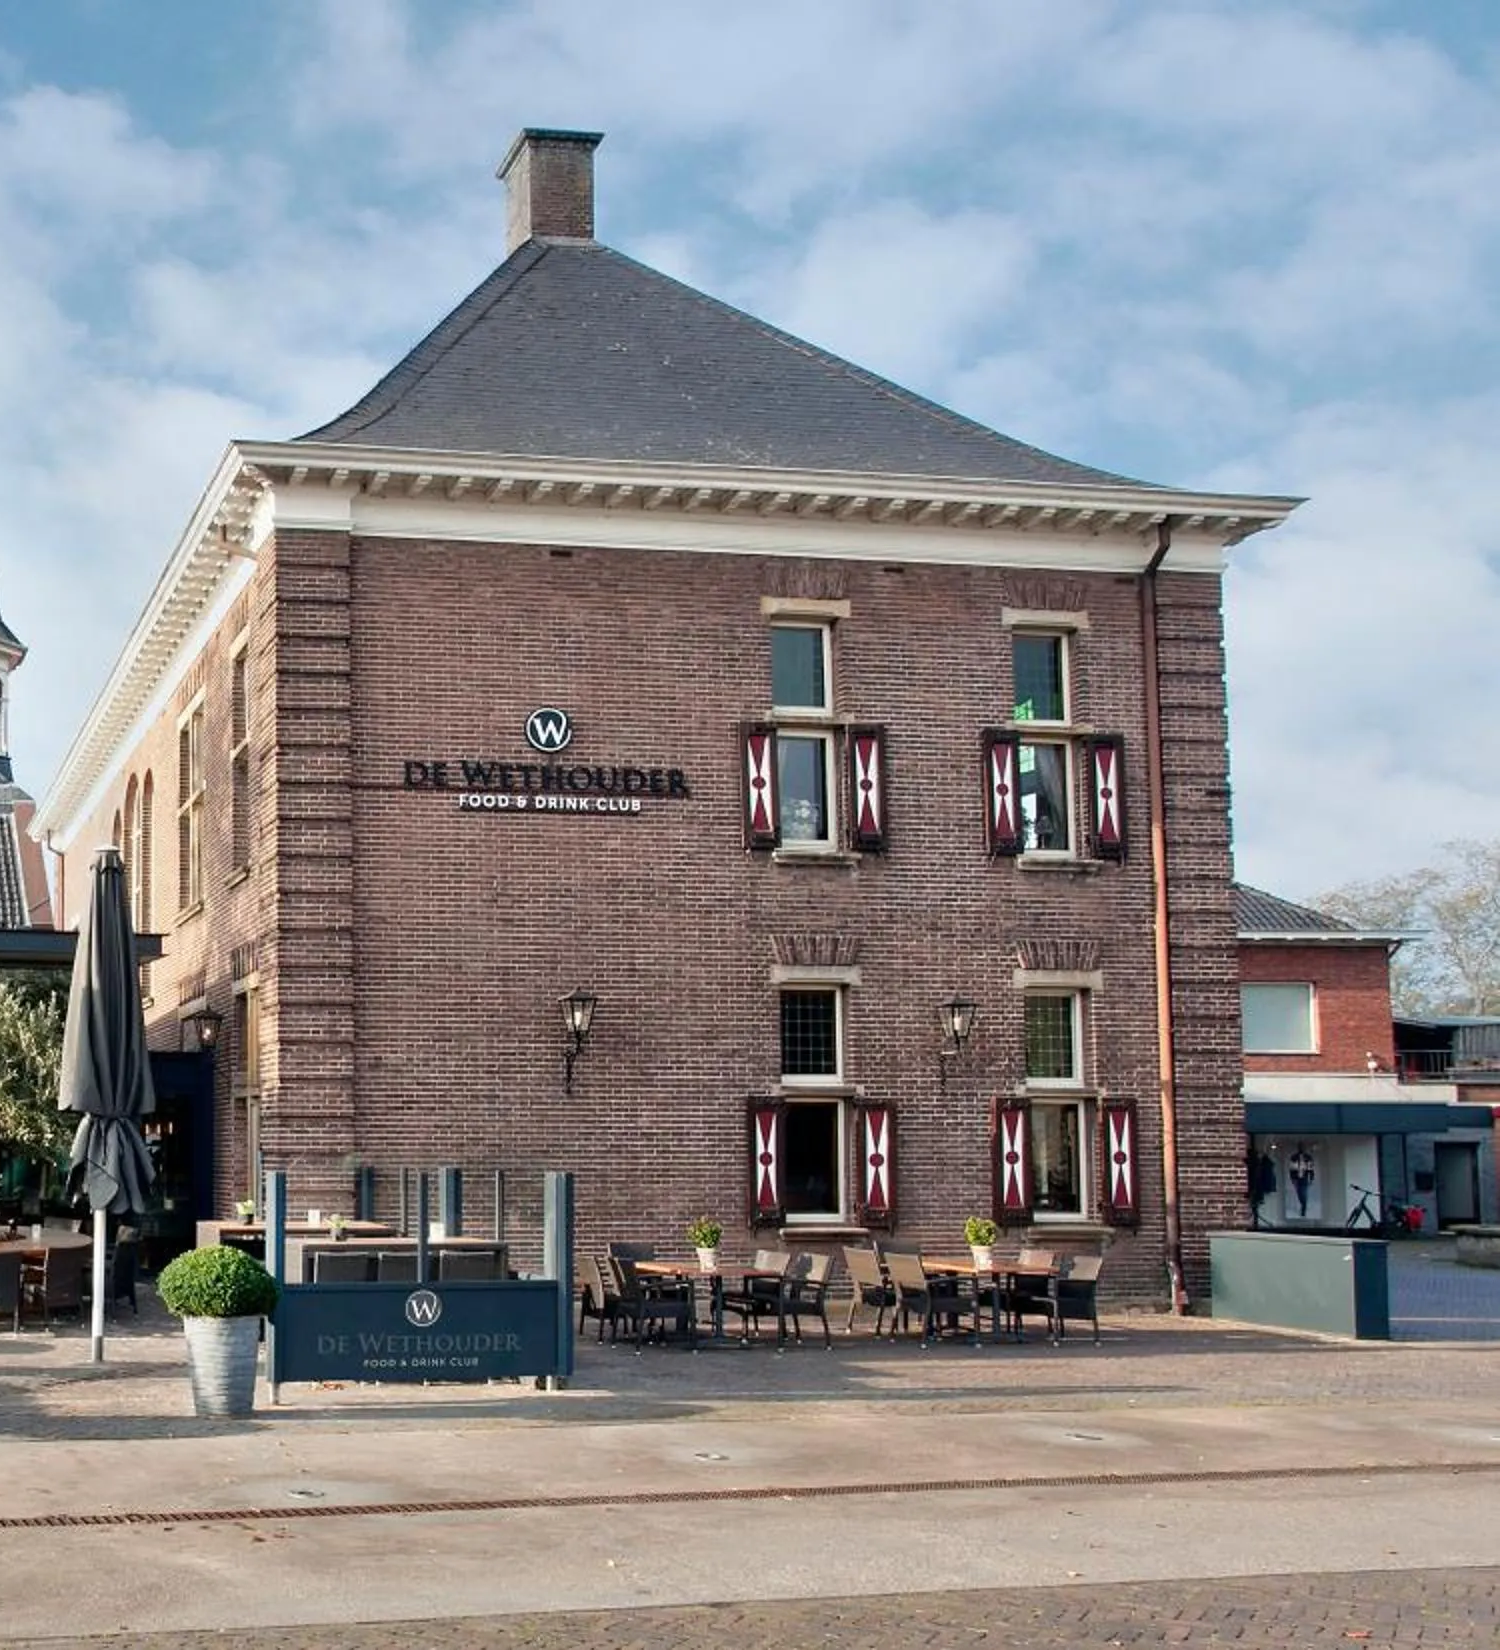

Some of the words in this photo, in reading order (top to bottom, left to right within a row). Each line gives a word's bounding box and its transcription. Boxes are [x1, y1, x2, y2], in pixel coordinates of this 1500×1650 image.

[531, 709, 568, 745] W
[403, 760, 449, 788] DE
[459, 759, 690, 796] WETHOUDER
[458, 794, 509, 808] FOOD
[516, 795, 526, 809] &
[535, 795, 589, 811] DRINK
[597, 797, 641, 812] CLUB
[411, 1291, 438, 1320] W
[317, 1334, 349, 1355] DE
[358, 1332, 521, 1354] WETHOUDER
[363, 1358, 397, 1368] FOOD
[400, 1359, 407, 1367] &
[411, 1357, 445, 1368] DRINK
[449, 1357, 479, 1367] CLUB
